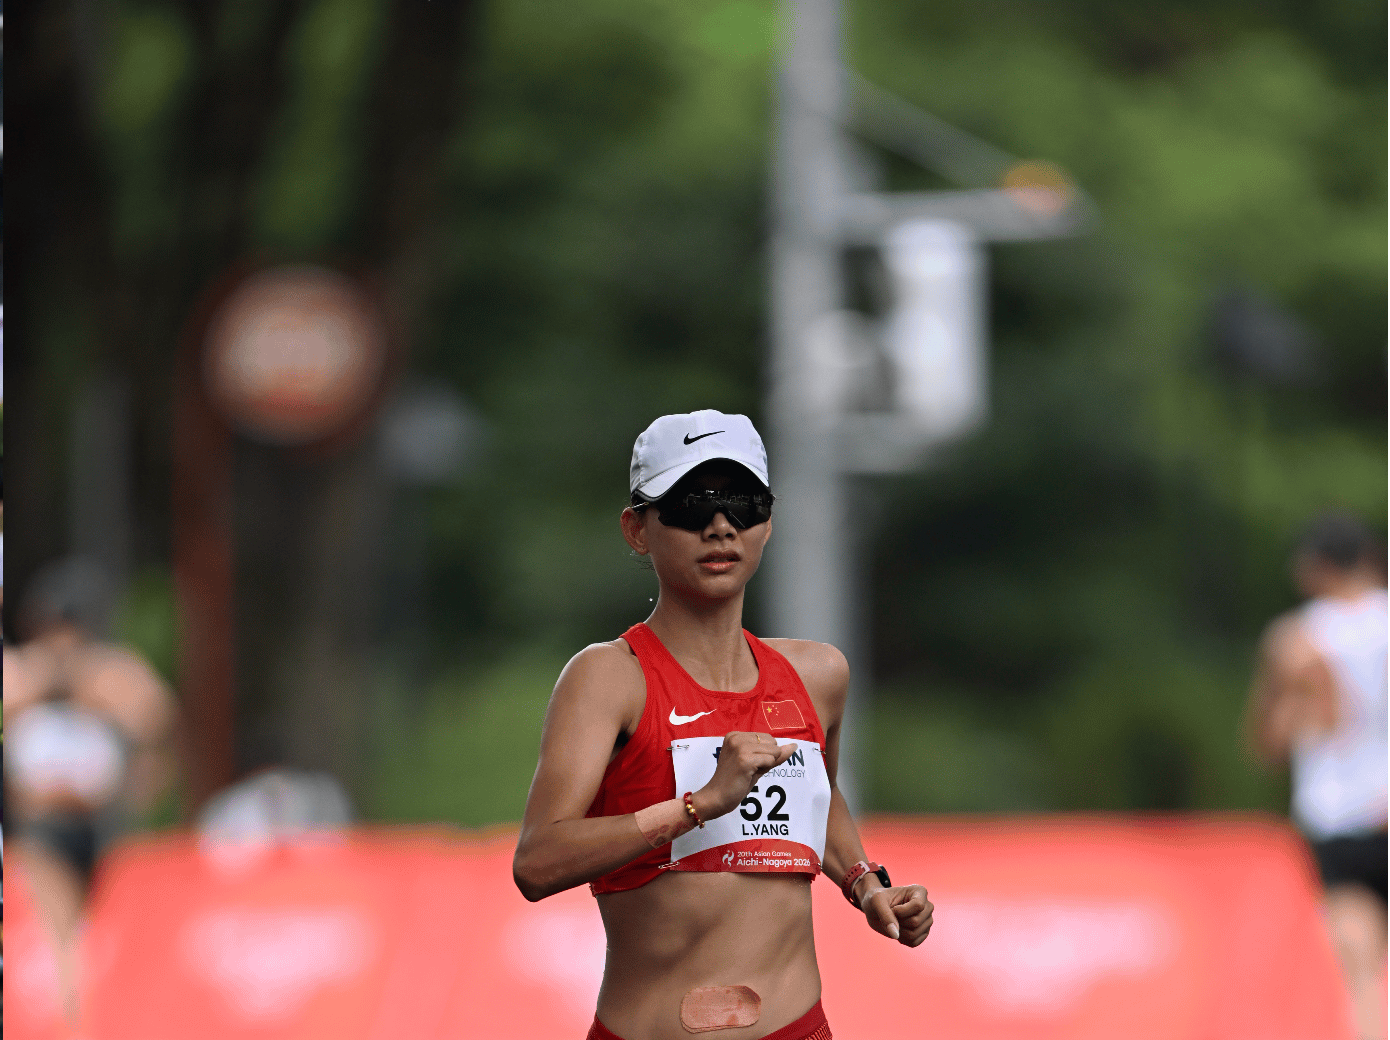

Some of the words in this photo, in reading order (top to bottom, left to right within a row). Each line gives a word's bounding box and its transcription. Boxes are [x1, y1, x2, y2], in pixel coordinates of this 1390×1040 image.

[740, 785, 789, 821] 52
[742, 823, 789, 835] L.YANG
[737, 857, 792, 867] Aichi-Nagoya
[794, 858, 810, 866] 2026
